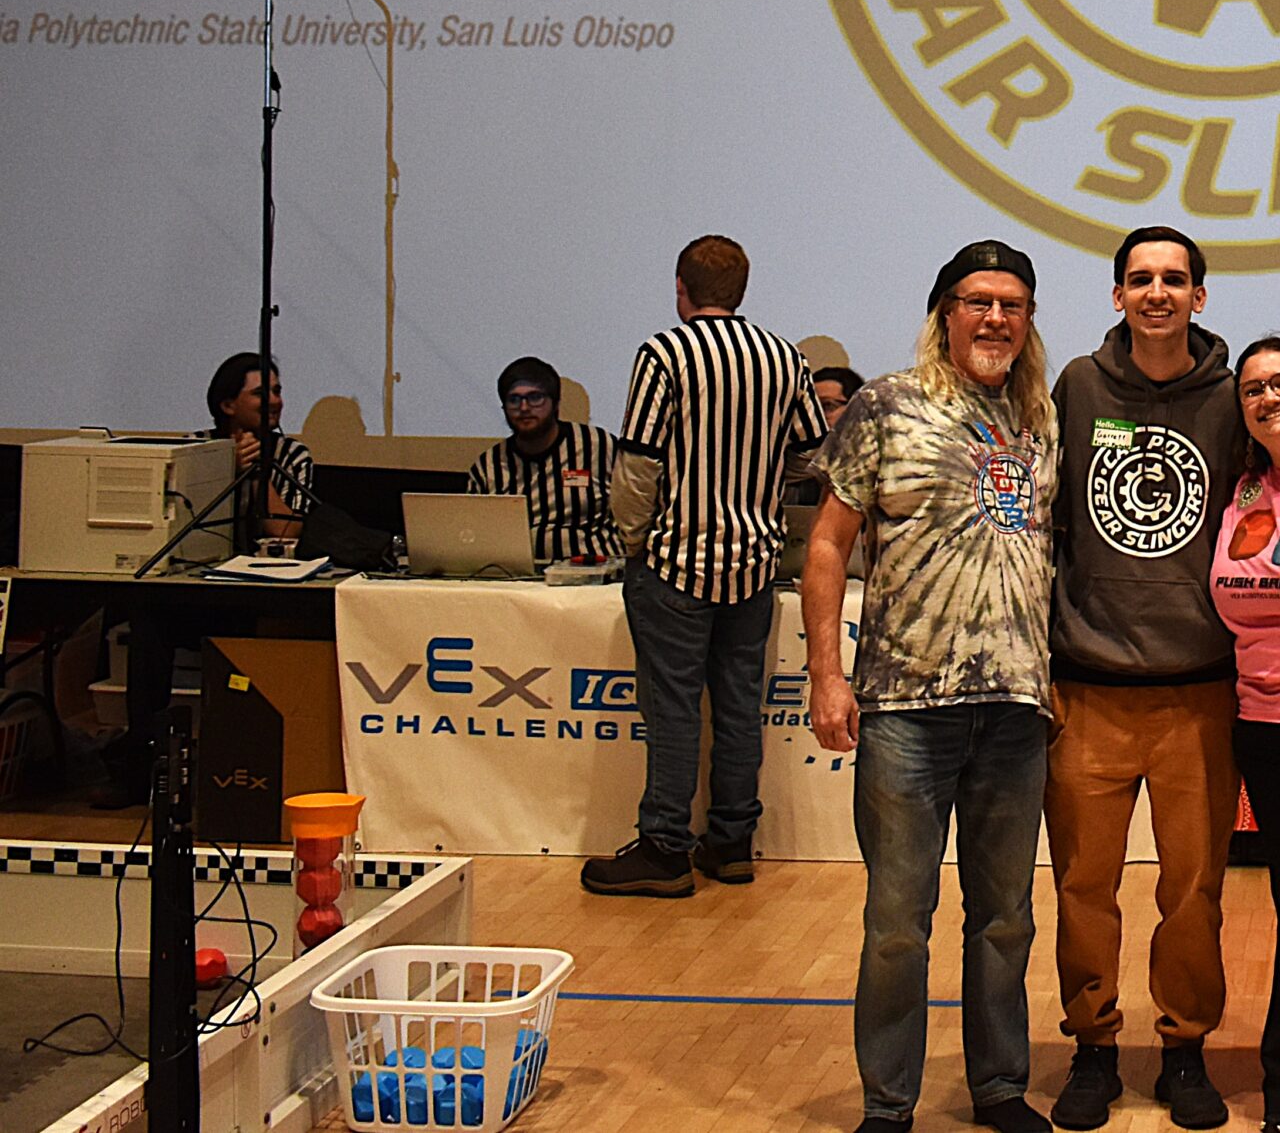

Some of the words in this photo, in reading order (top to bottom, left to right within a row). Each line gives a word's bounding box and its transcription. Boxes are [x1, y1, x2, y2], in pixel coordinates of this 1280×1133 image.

[28, 12, 189, 49] Polytechnic
[436, 14, 495, 47] San
[502, 15, 563, 47] Luis
[573, 16, 675, 52] Obispo
[1147, 435, 1200, 471] POLY
[1094, 477, 1122, 535] GEAR
[1122, 482, 1203, 549] SLINGERS
[1216, 577, 1255, 588] PUSH
[345, 637, 553, 709] VEX
[577, 675, 637, 705] IQ
[360, 714, 648, 741] CHALLENGE
[213, 769, 269, 790] VEX
